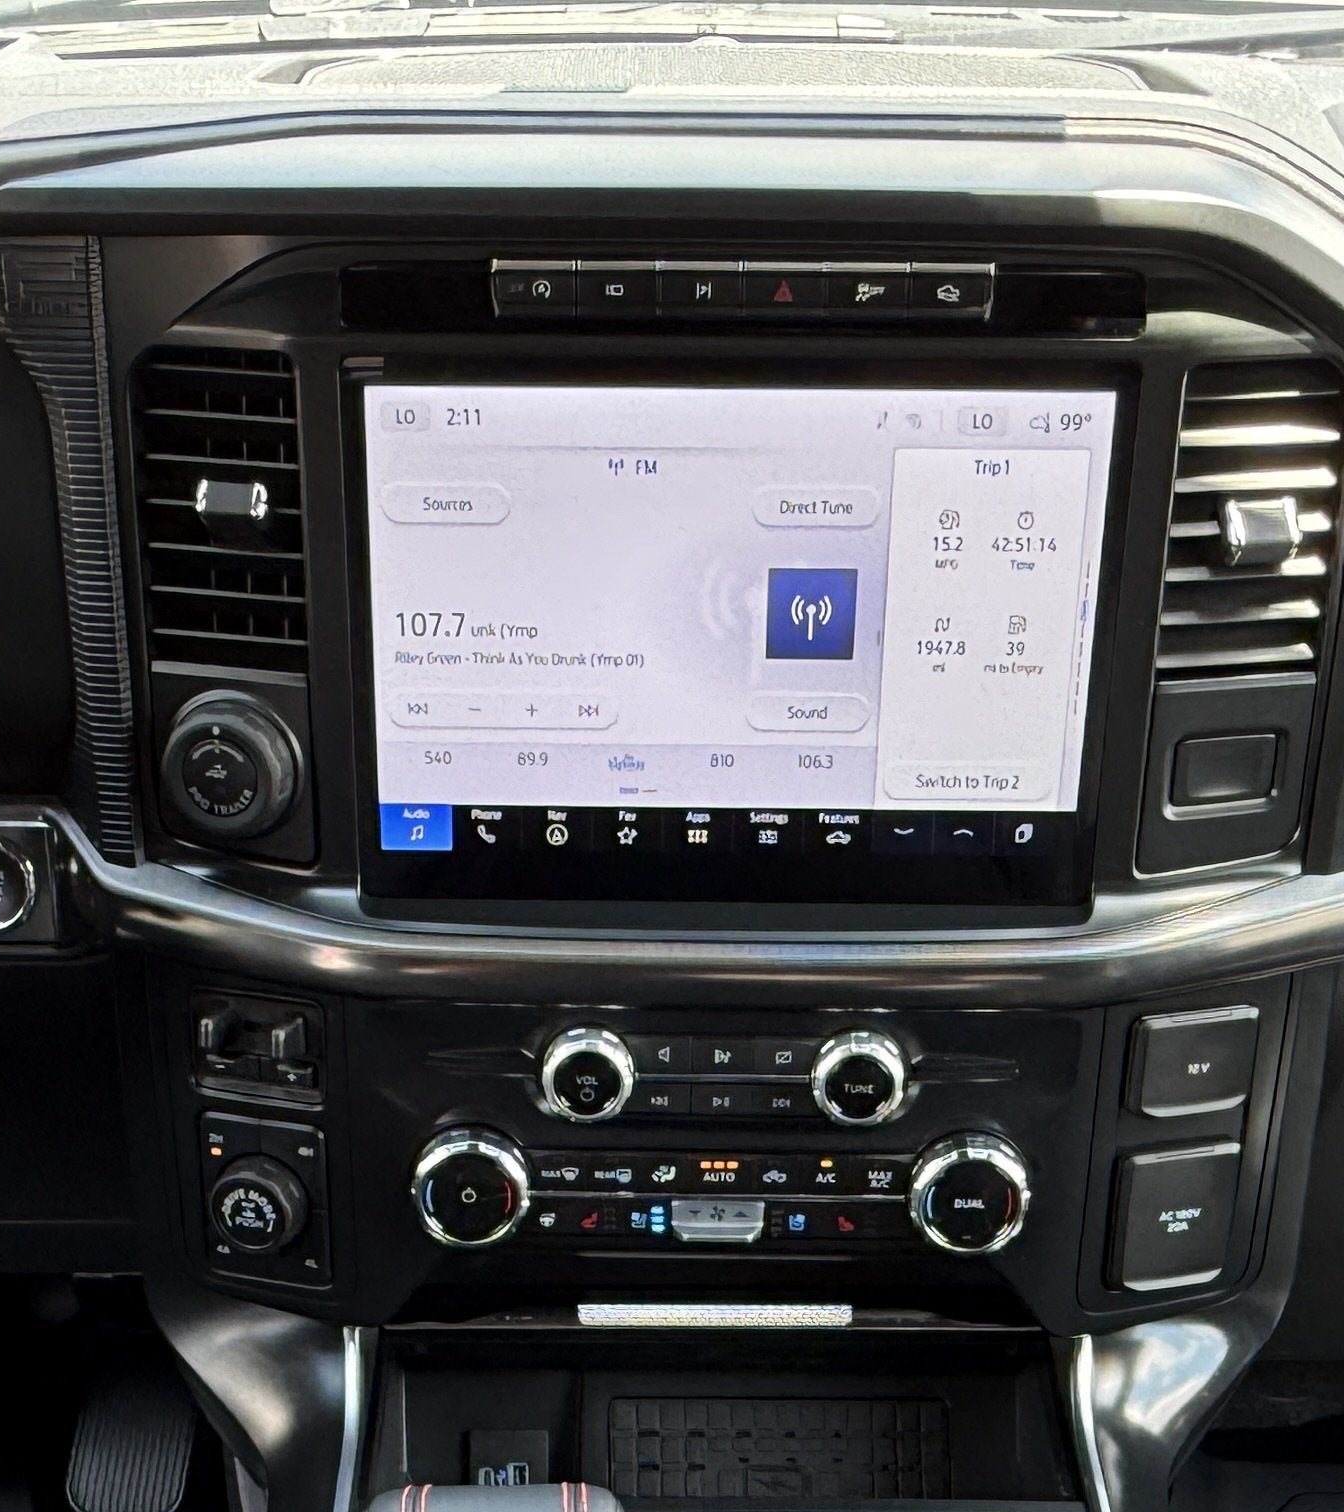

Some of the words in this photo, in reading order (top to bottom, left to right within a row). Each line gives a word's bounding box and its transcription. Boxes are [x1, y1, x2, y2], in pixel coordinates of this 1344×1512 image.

[396, 408, 416, 425] LO
[446, 408, 482, 426] 2:11
[972, 413, 993, 430] LO
[1059, 412, 1092, 431] 99°
[636, 459, 658, 475] FM
[974, 459, 1001, 477] Trip
[1004, 459, 1011, 475] 1
[423, 497, 473, 512] Sources
[779, 500, 817, 515] Direct
[821, 501, 853, 515] Tune
[933, 537, 964, 552] 15.2
[395, 612, 466, 637] 107.7
[471, 624, 497, 637] unk
[500, 623, 538, 640] (Ymp
[916, 641, 966, 656] 1947.8
[1005, 641, 1025, 656] 39
[427, 652, 461, 665] Green
[472, 651, 505, 664] Think
[508, 653, 523, 666] As
[525, 653, 549, 666] You
[552, 653, 586, 666] Drunk
[590, 653, 622, 668] (Ymp
[625, 653, 644, 668] 01)
[787, 705, 828, 719] Sound
[424, 751, 453, 766] 540
[517, 752, 548, 766] 89.9
[710, 754, 735, 768] 810
[797, 754, 834, 769] 106.3
[915, 774, 962, 789] Switch
[965, 775, 980, 789] to
[983, 775, 1009, 790] Trip
[1011, 775, 1020, 790] 2
[213, 789, 254, 815] TRAILER
[402, 809, 431, 820] Audio
[470, 809, 503, 821] Phone
[685, 811, 712, 823] Apps
[749, 812, 789, 825] Settings
[576, 1075, 599, 1086] VOL
[843, 1083, 875, 1095] TUNE
[702, 1172, 736, 1183] AUTO
[815, 1172, 837, 1184] A/C
[953, 1198, 986, 1209] DUAL
